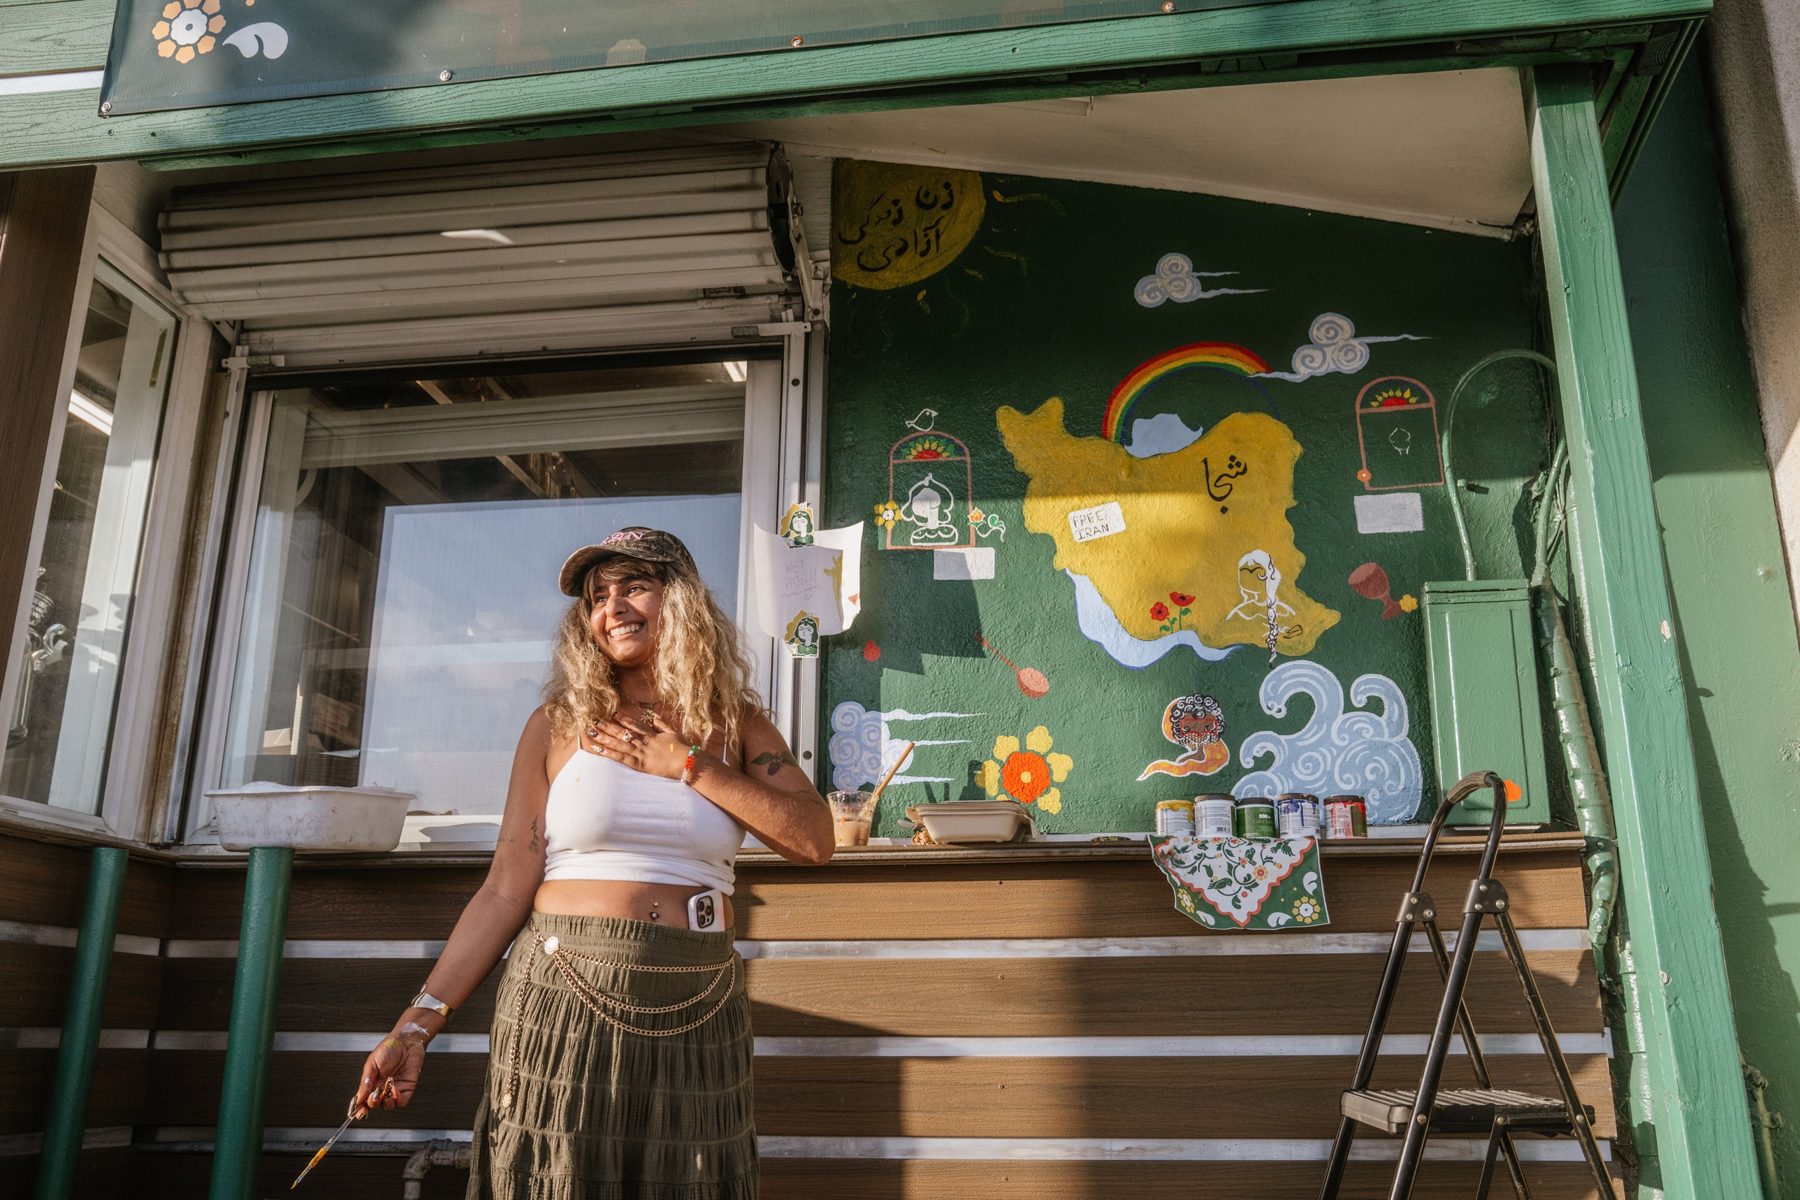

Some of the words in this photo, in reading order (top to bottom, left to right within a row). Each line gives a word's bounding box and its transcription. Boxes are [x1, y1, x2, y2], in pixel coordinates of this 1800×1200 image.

[915, 181, 954, 210] زن
[856, 215, 945, 273] آزادی
[1078, 523, 1110, 541] IRAN
